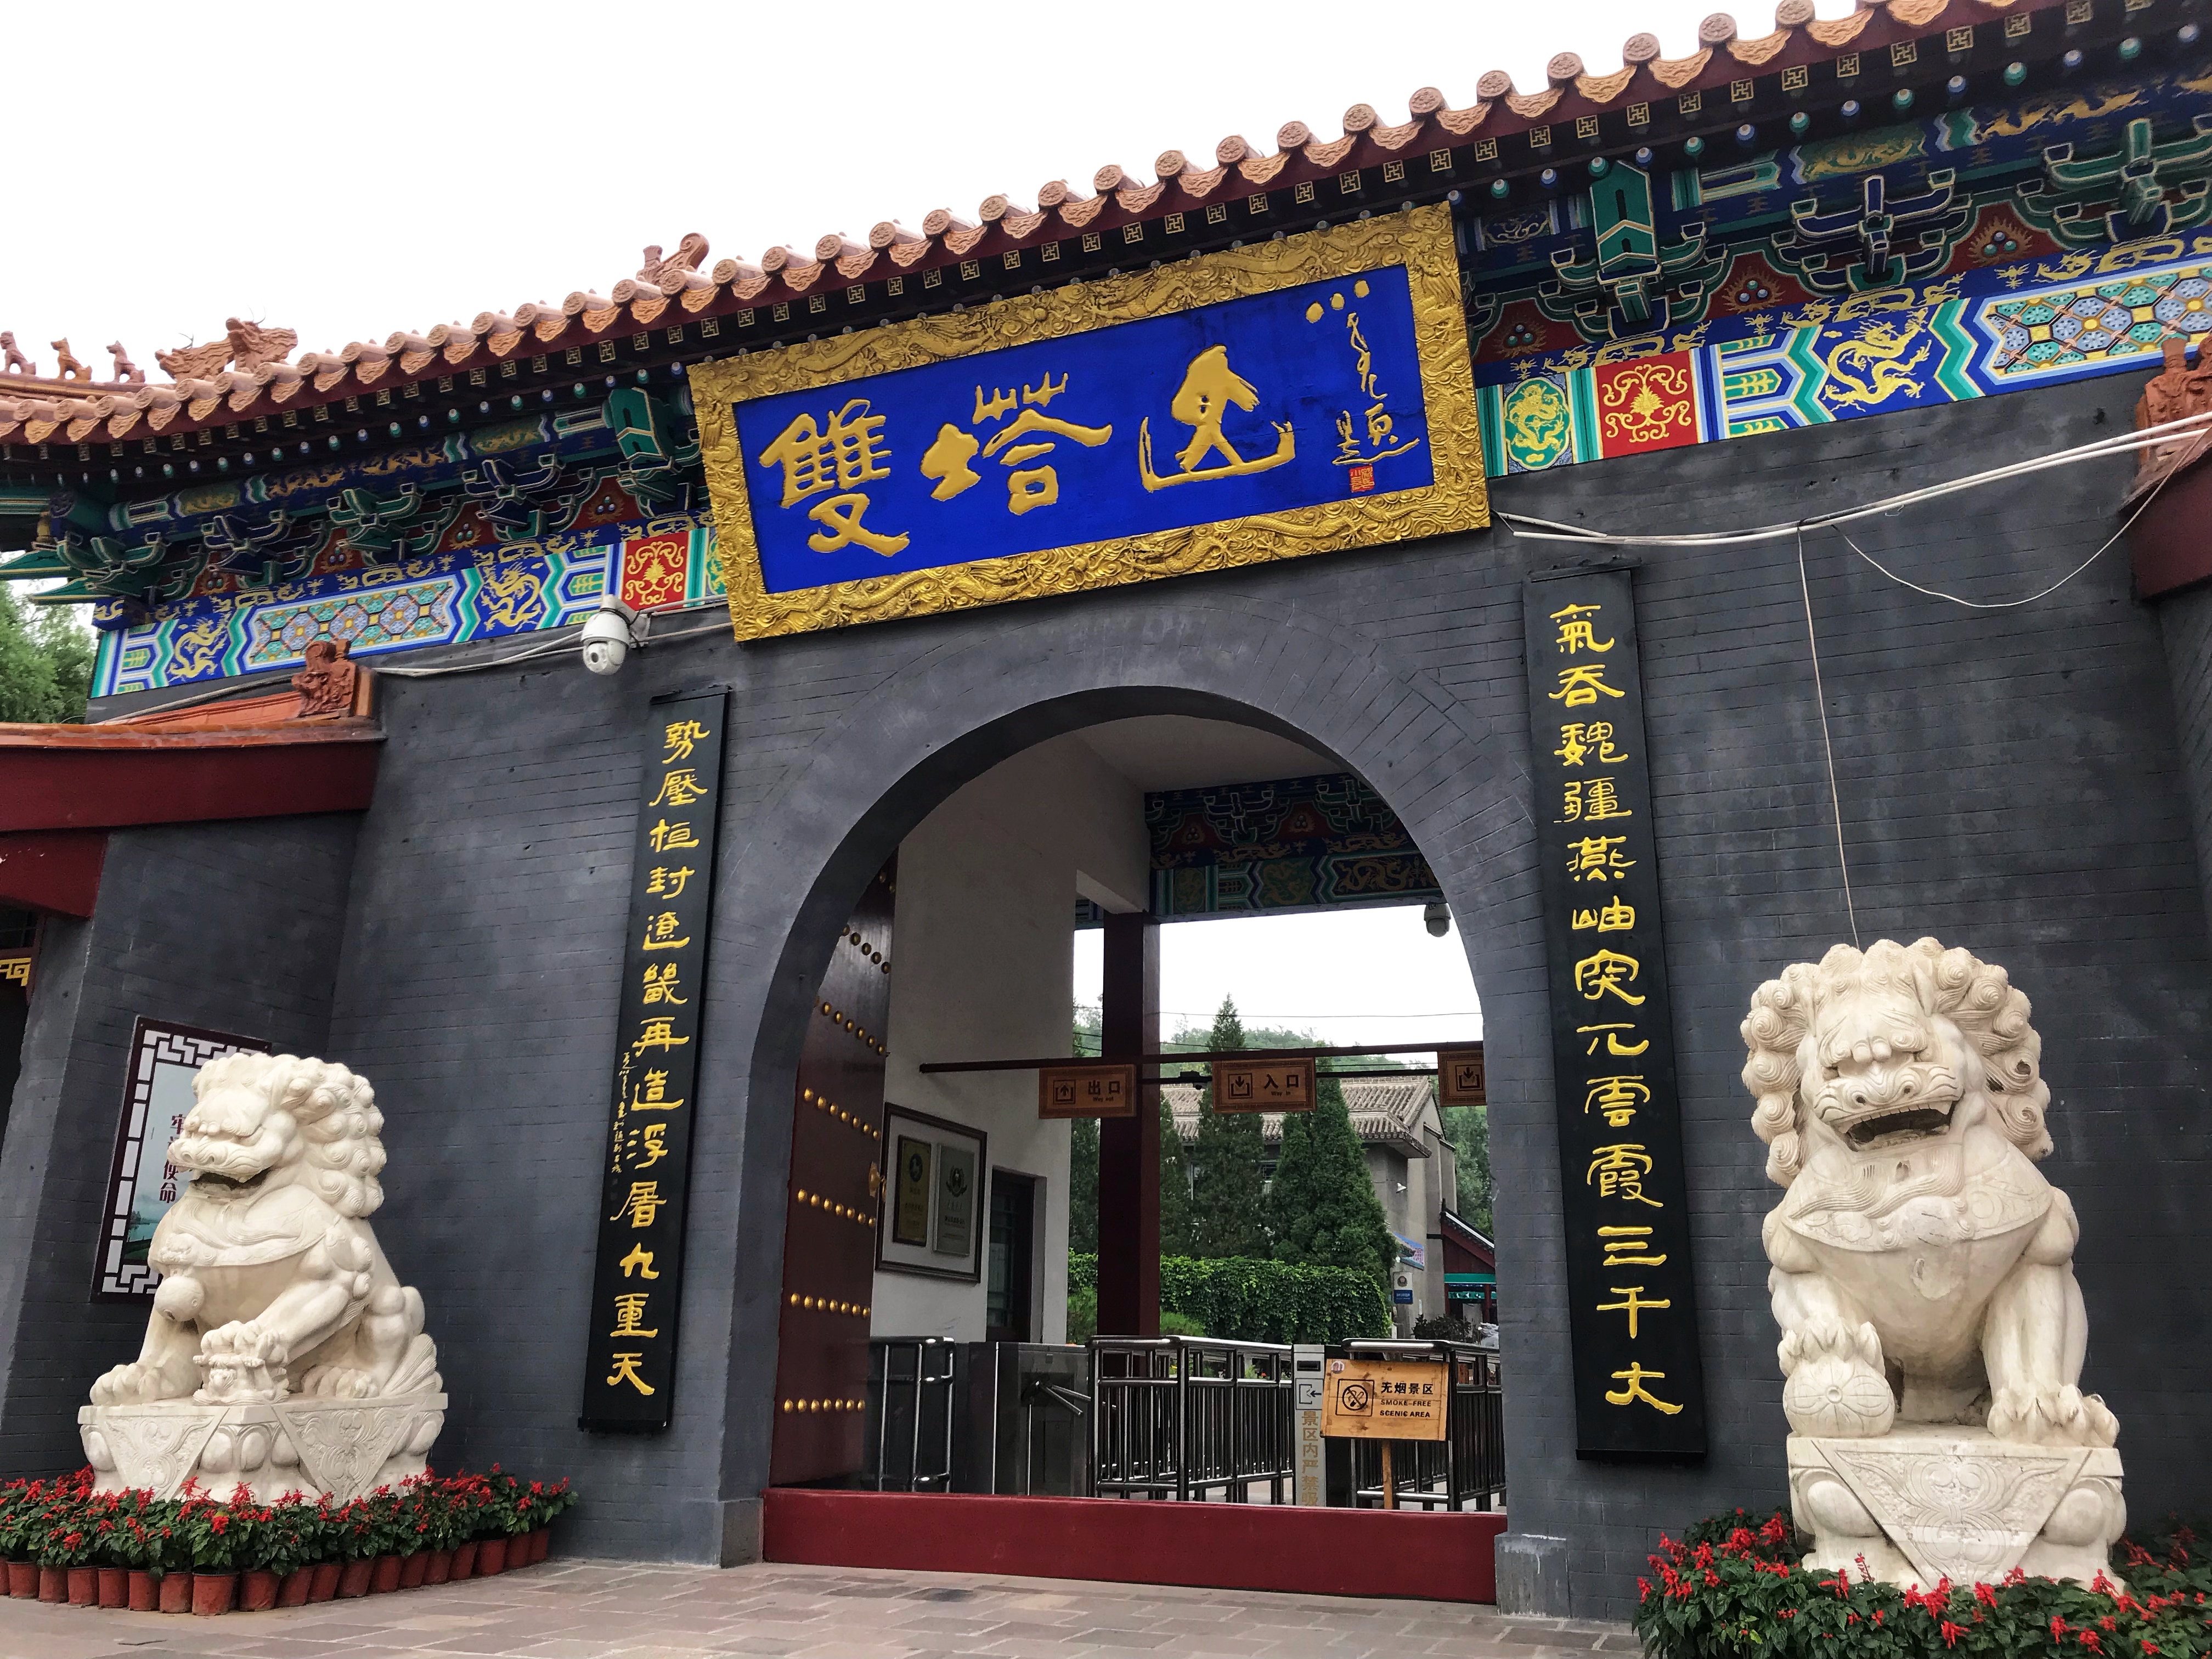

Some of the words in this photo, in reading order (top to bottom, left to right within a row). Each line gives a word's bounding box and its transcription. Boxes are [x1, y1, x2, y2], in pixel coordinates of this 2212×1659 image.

[1088, 1080, 1120, 1095] 出口
[1264, 1074, 1299, 1089] 入口
[159, 1114, 185, 1204] 牢使命
[1381, 1382, 1434, 1395] 无烟景区
